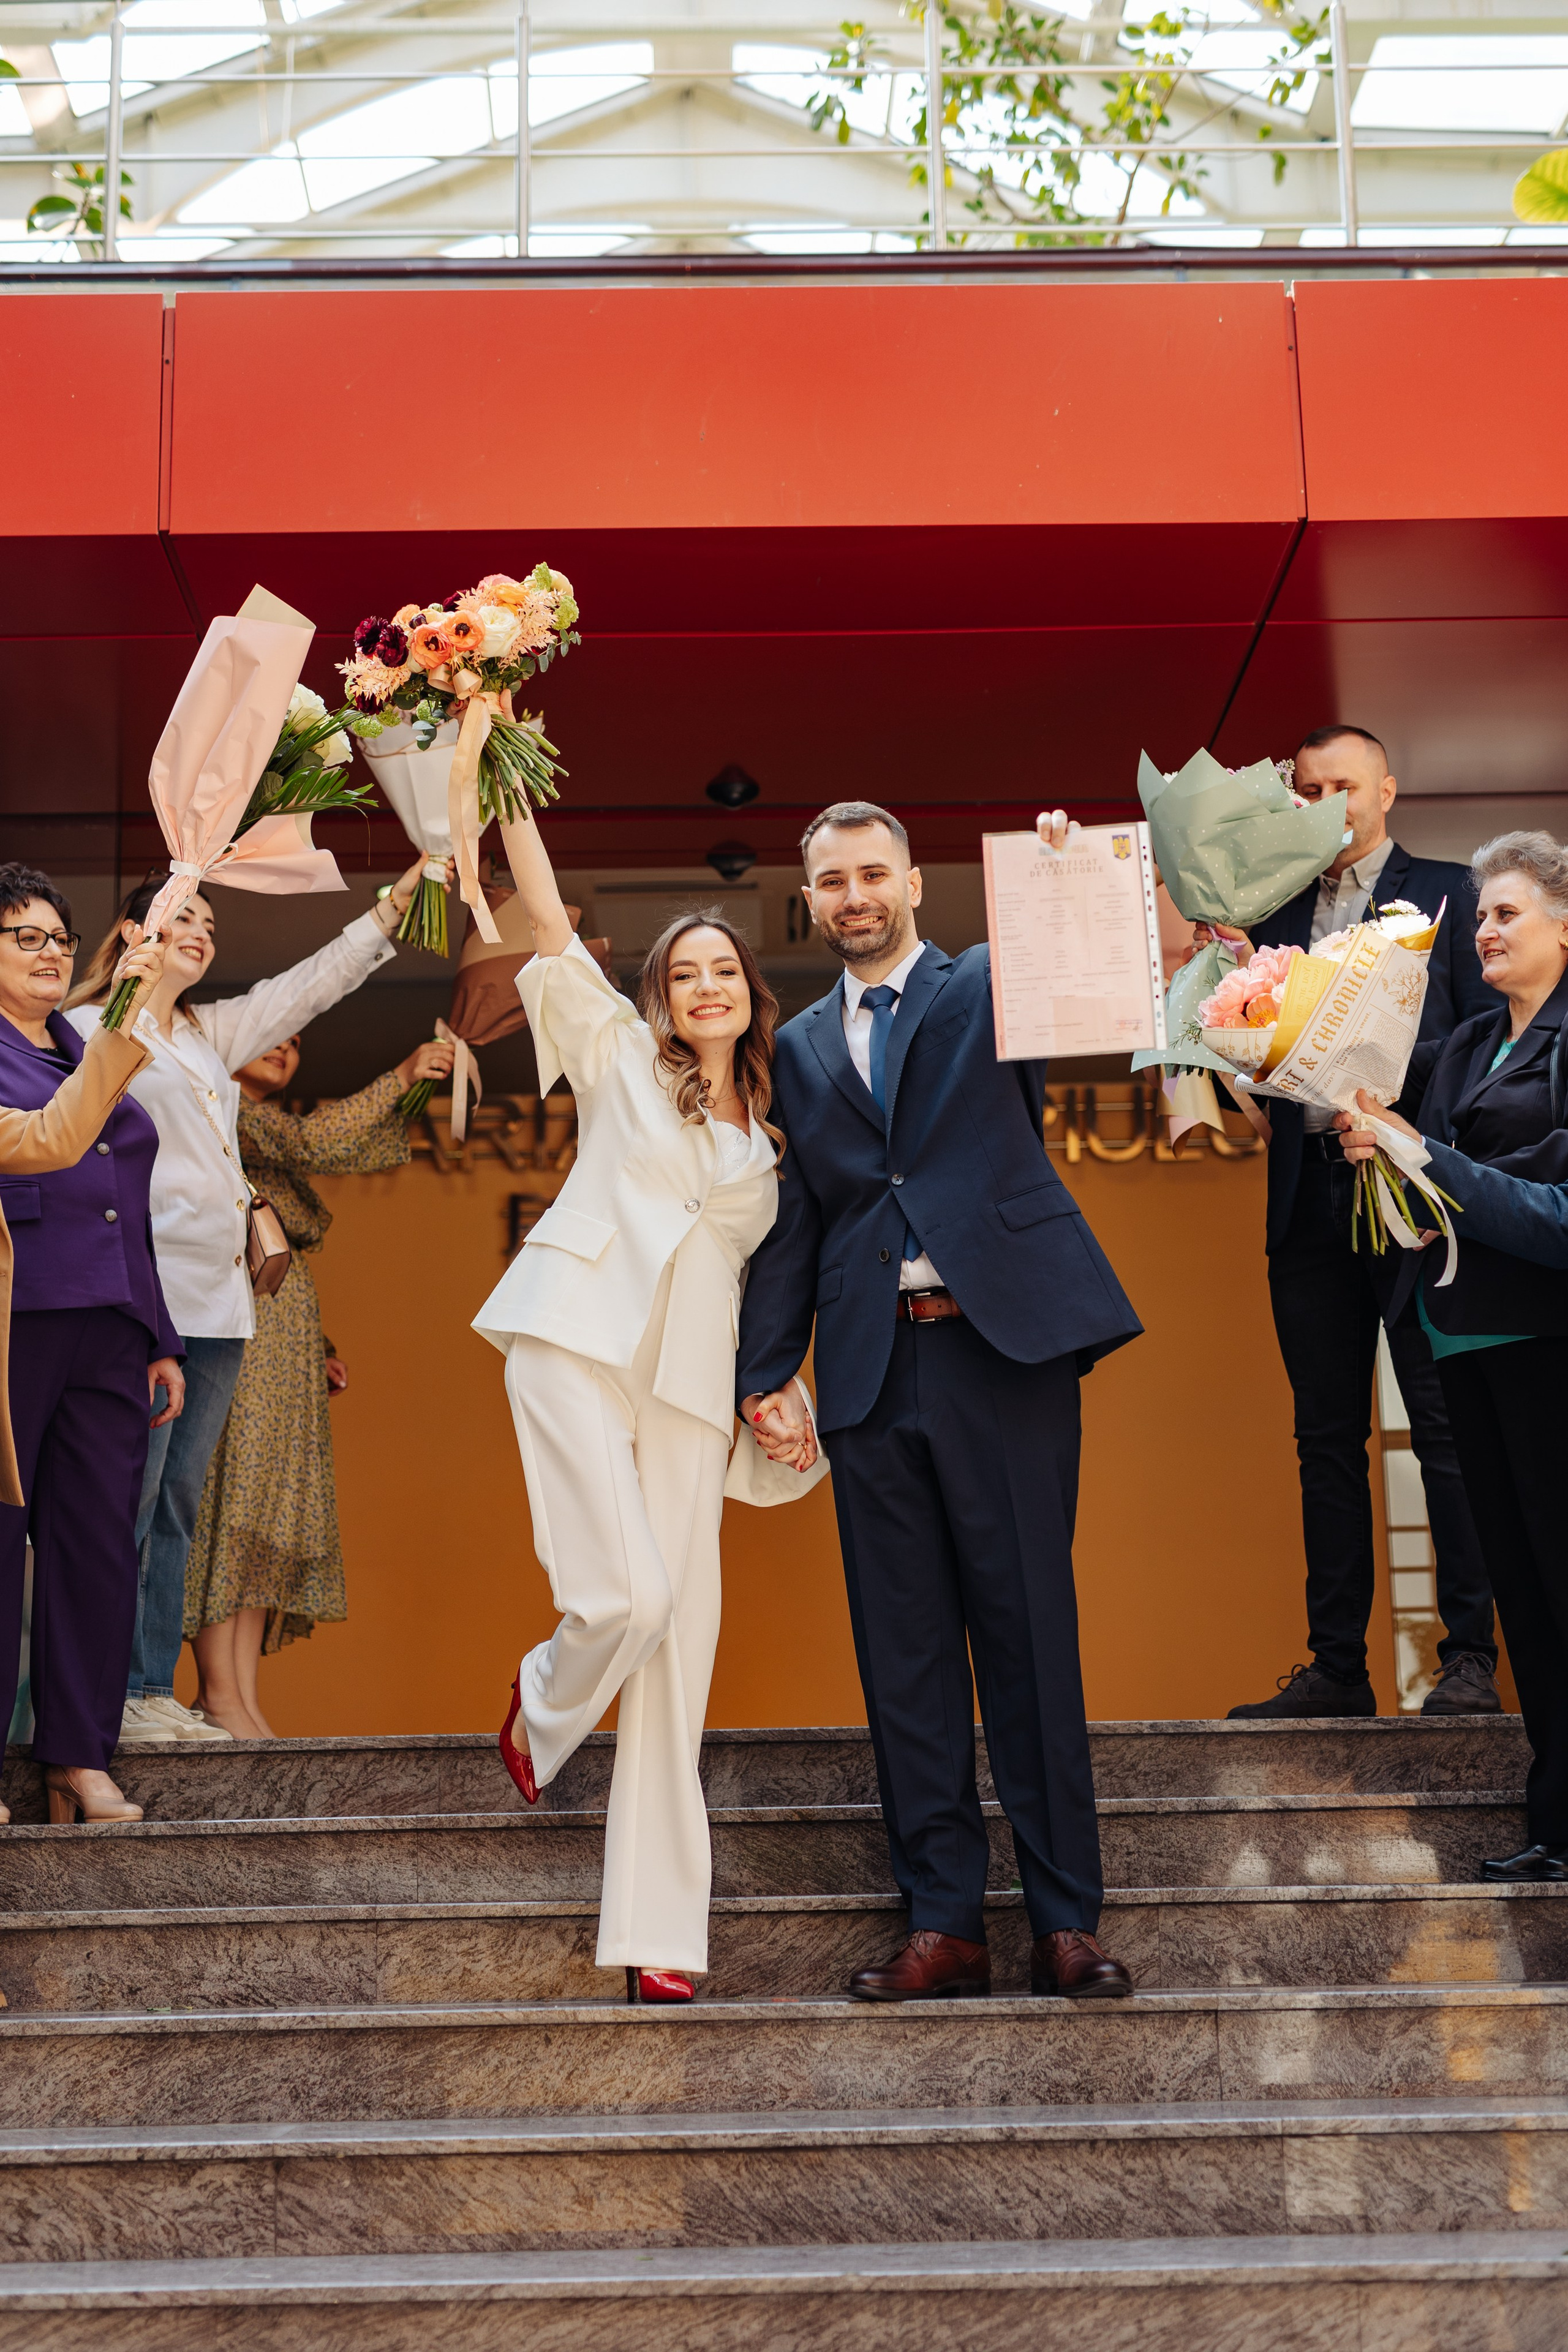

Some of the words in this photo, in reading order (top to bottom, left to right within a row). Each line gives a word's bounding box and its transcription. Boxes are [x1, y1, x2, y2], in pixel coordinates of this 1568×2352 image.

[1035, 859, 1098, 870] CERTIFICAT
[1298, 1056, 1319, 1072] &
[1309, 941, 1382, 1054] CHRONICLE
[1336, 1034, 1359, 1064] Everything
[1340, 1056, 1349, 1066] but
[1347, 1047, 1357, 1058] you
[1356, 1037, 1365, 1048] win
[1314, 1088, 1325, 1098] the
[1324, 1071, 1338, 1089] days.
